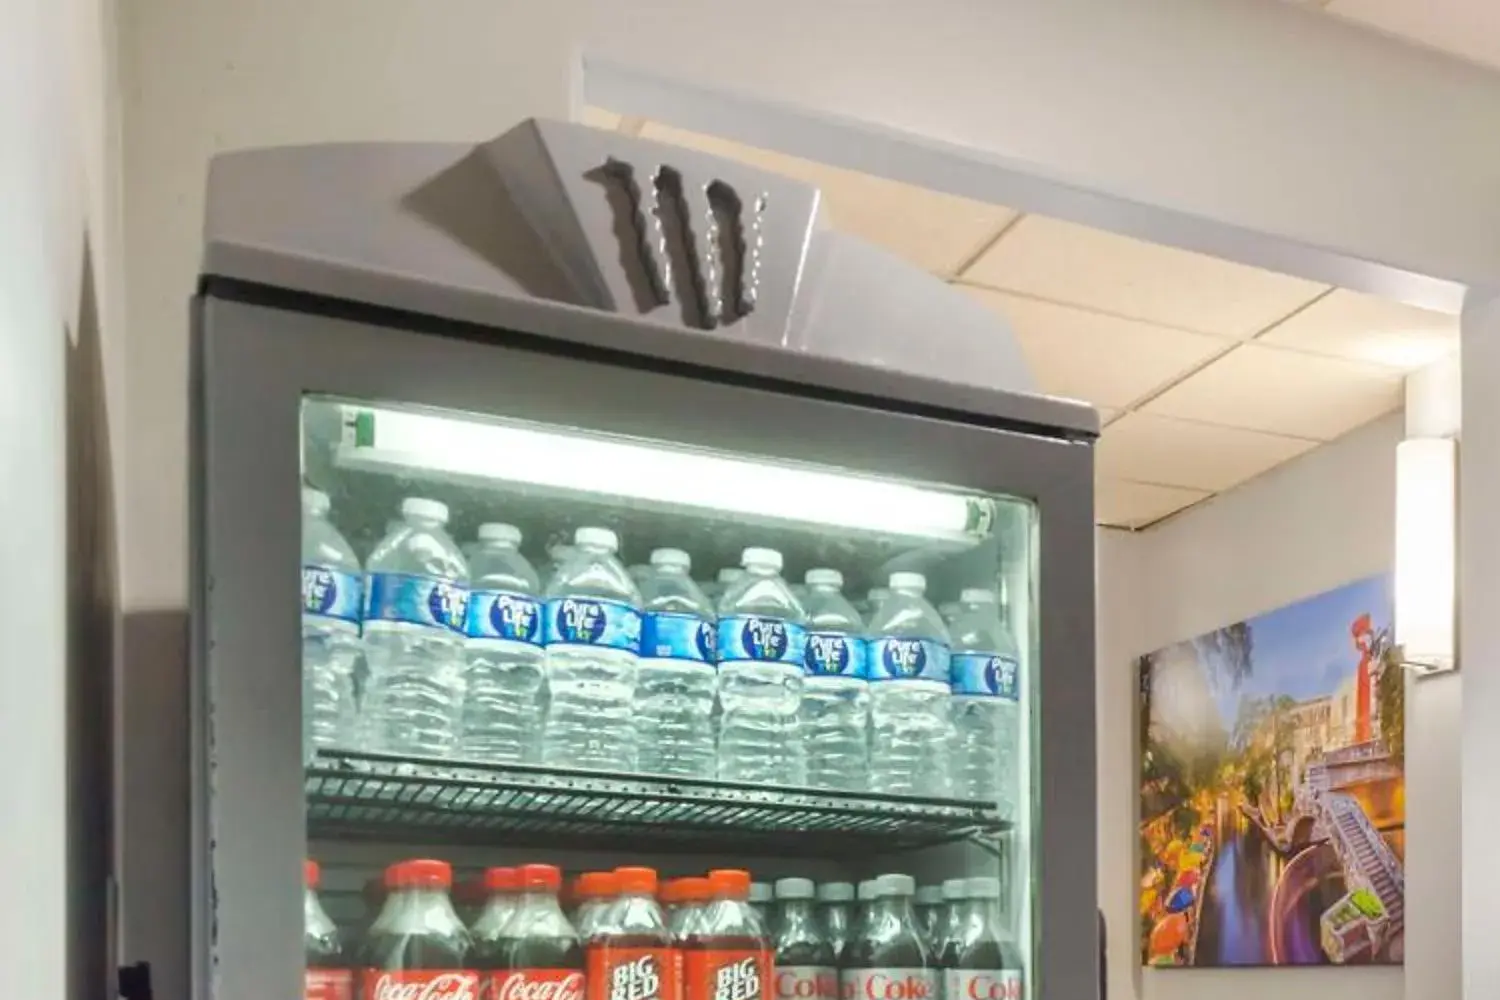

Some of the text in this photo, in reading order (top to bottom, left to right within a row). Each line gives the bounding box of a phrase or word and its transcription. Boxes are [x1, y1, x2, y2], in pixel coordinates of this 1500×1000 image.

[749, 619, 783, 635] Pure
[752, 630, 781, 655] Life
[811, 636, 843, 650] Pure
[814, 645, 841, 669] Life
[612, 955, 655, 986] BIG
[716, 957, 756, 986] BIG
